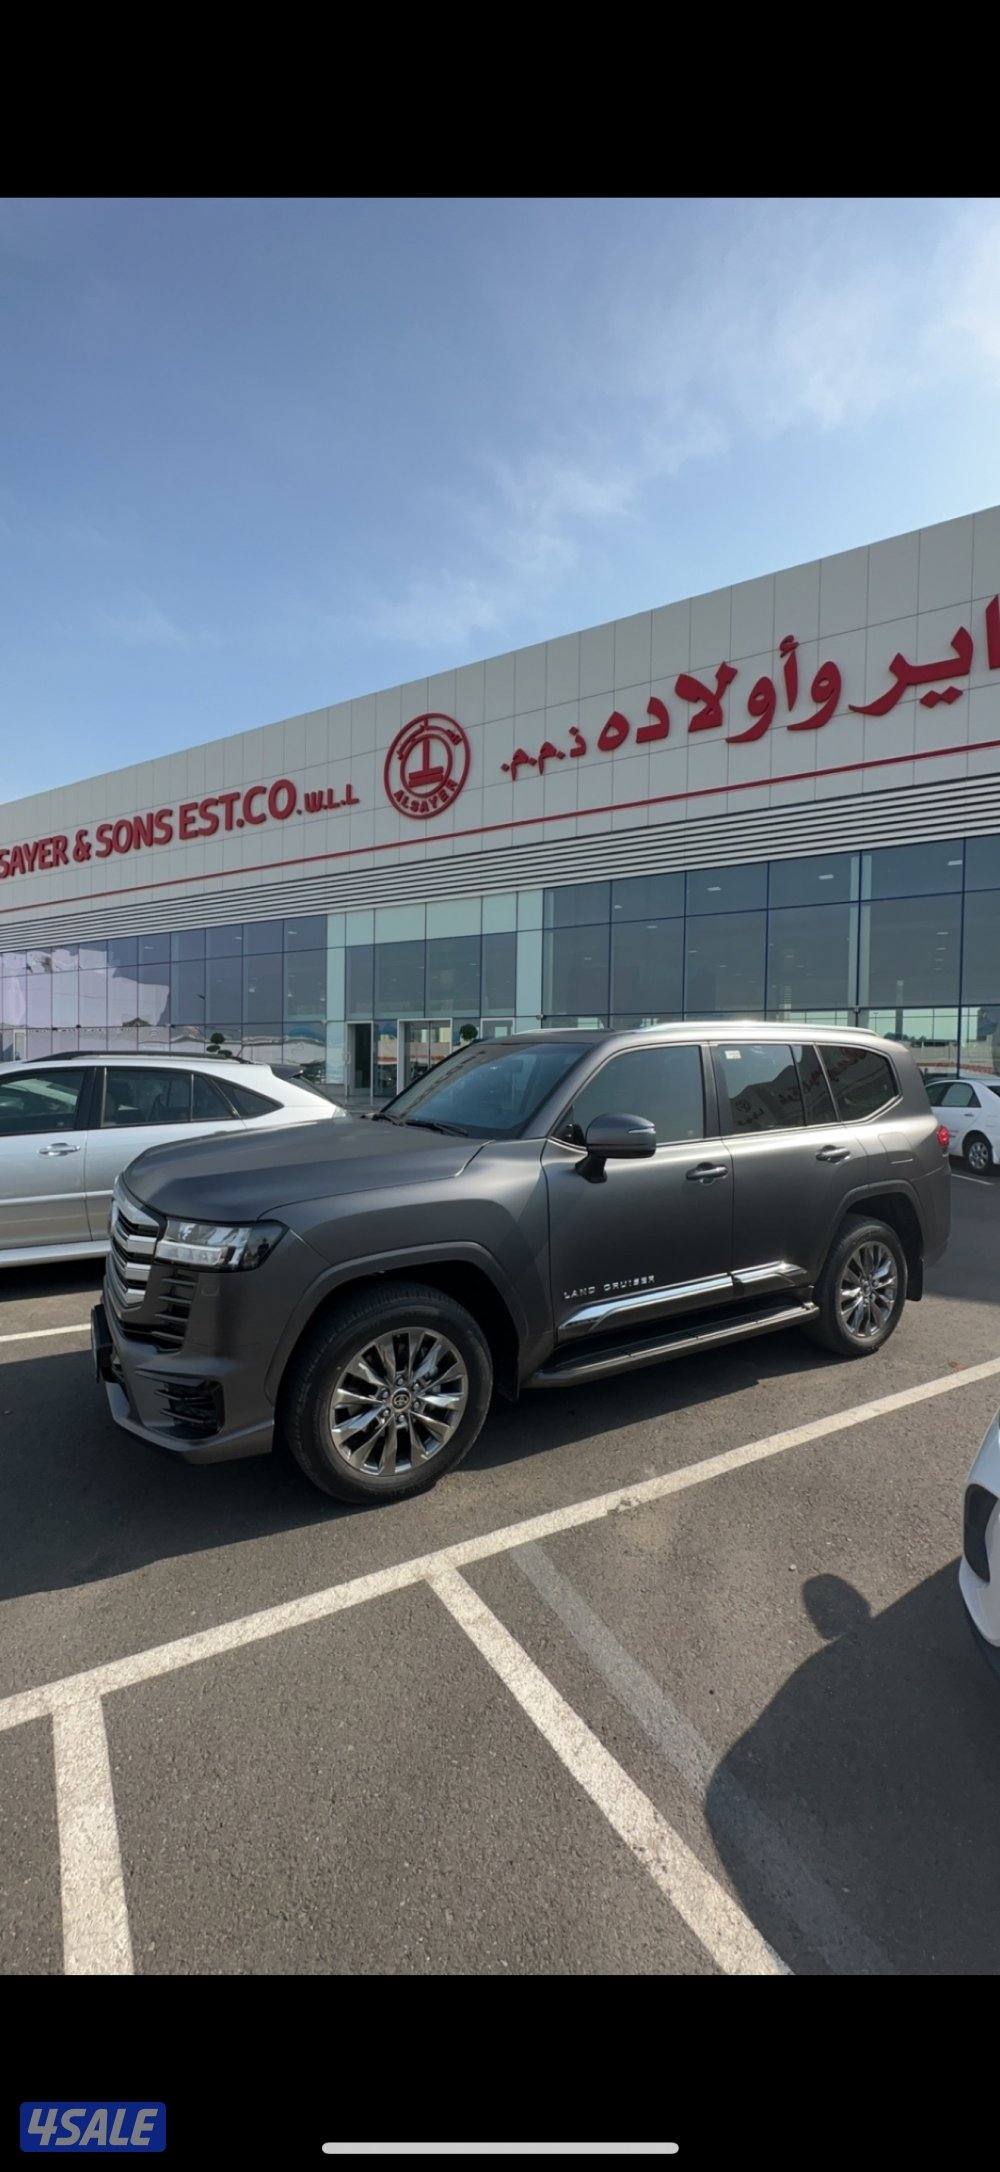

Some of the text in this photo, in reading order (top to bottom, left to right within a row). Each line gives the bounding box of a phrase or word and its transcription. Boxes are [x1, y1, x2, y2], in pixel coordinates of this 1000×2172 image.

[393, 778, 459, 813] ALSAYER
[72, 829, 92, 863] &
[95, 808, 174, 859] SONS
[563, 1274, 655, 1299] LAND CRUISER
